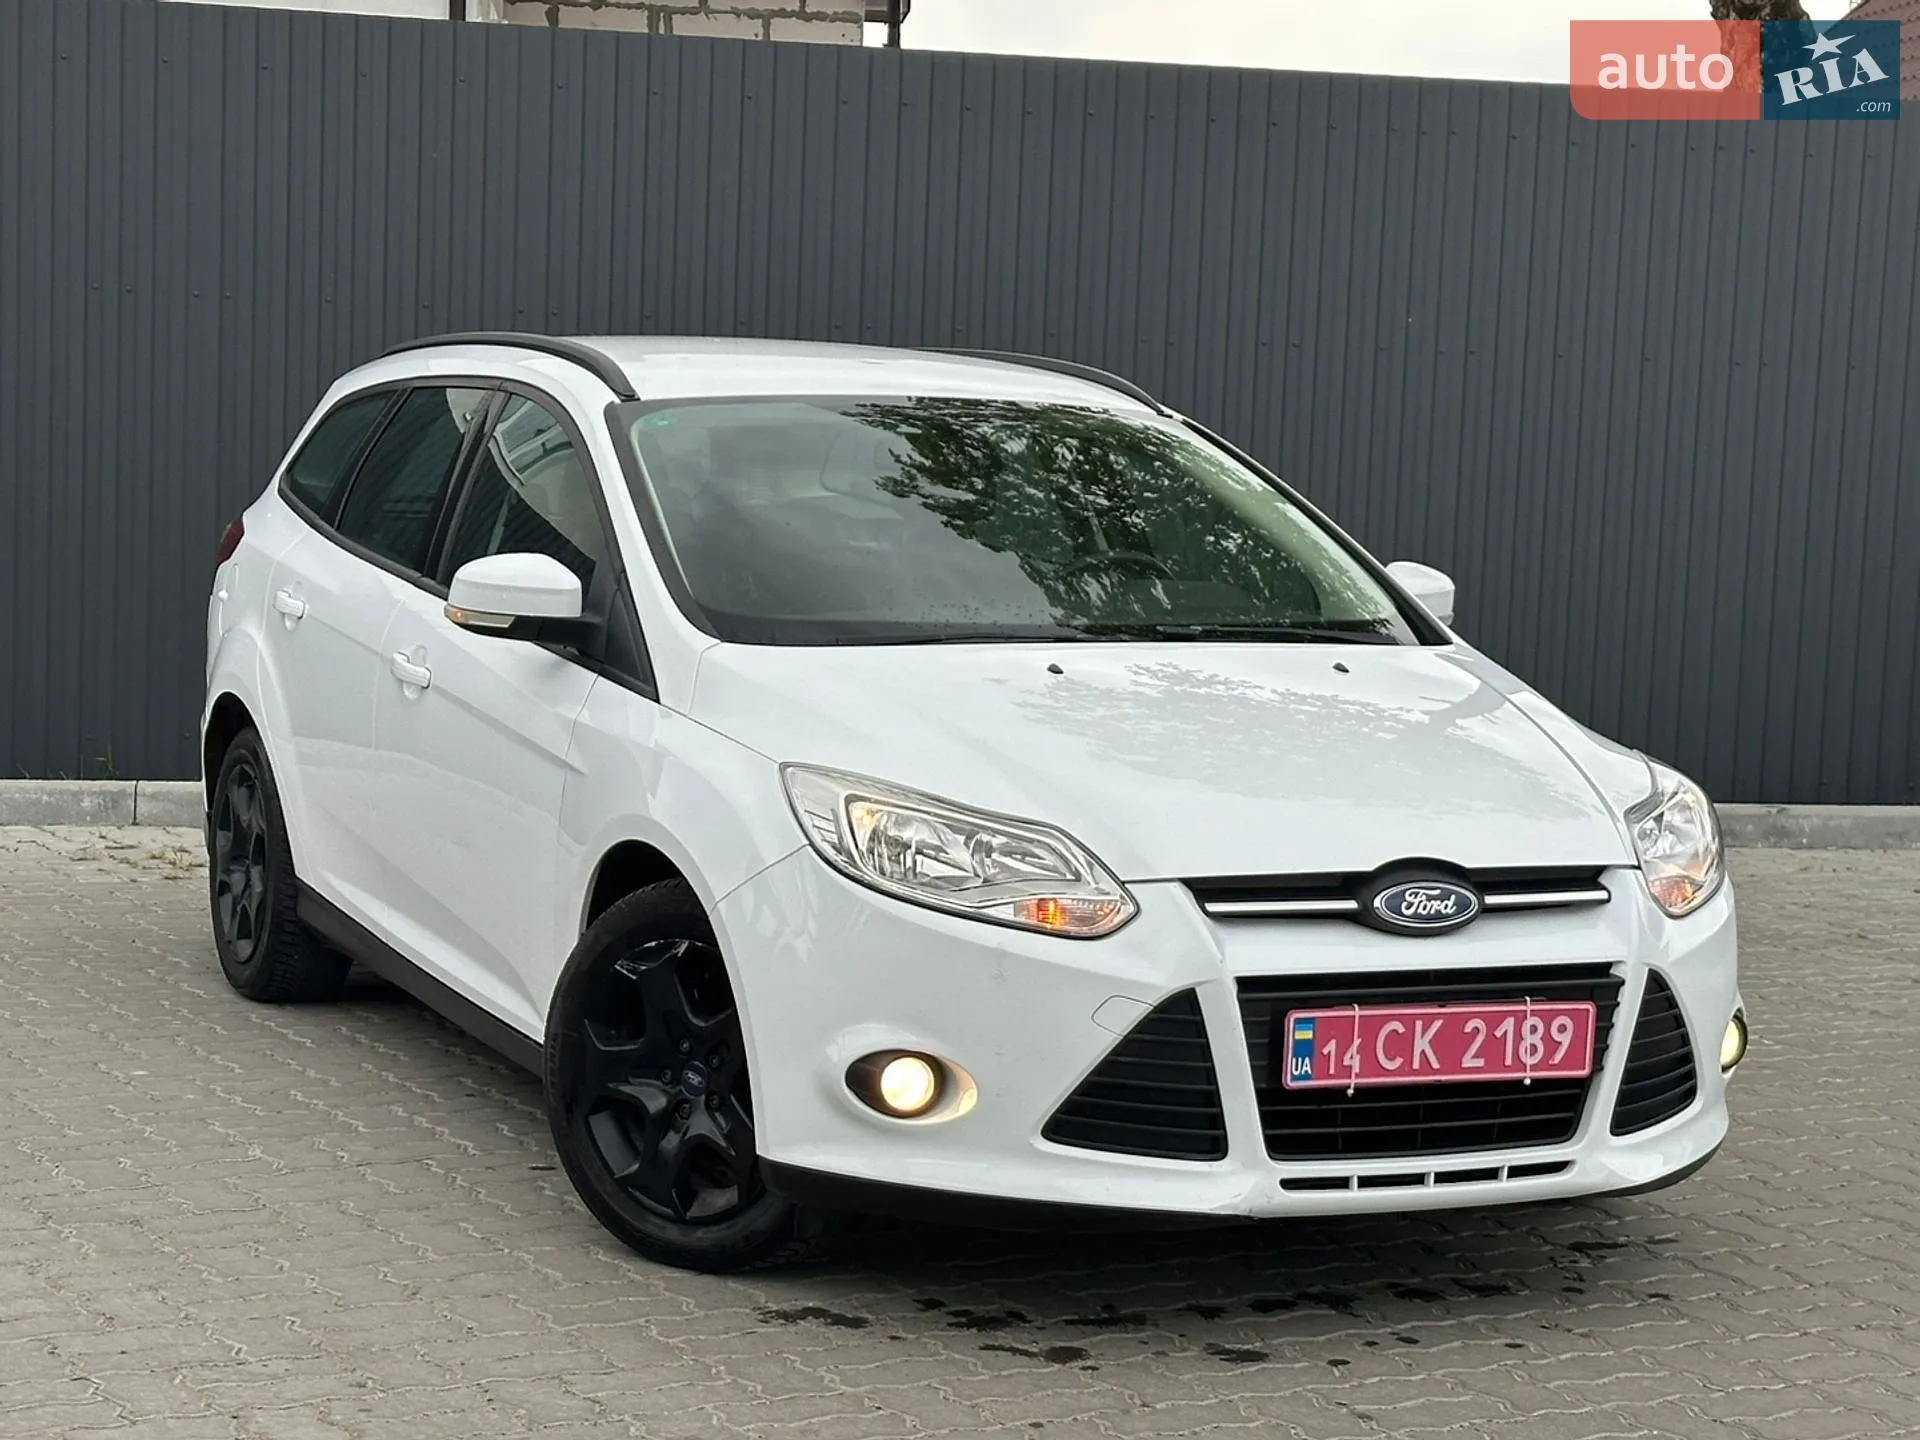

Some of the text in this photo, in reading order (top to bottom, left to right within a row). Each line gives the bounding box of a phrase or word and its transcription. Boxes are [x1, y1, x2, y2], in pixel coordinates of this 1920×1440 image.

[1401, 888, 1457, 916] Ford
[1321, 1015, 1574, 1075] 14 CK 2189
[1291, 1058, 1312, 1075] UA
